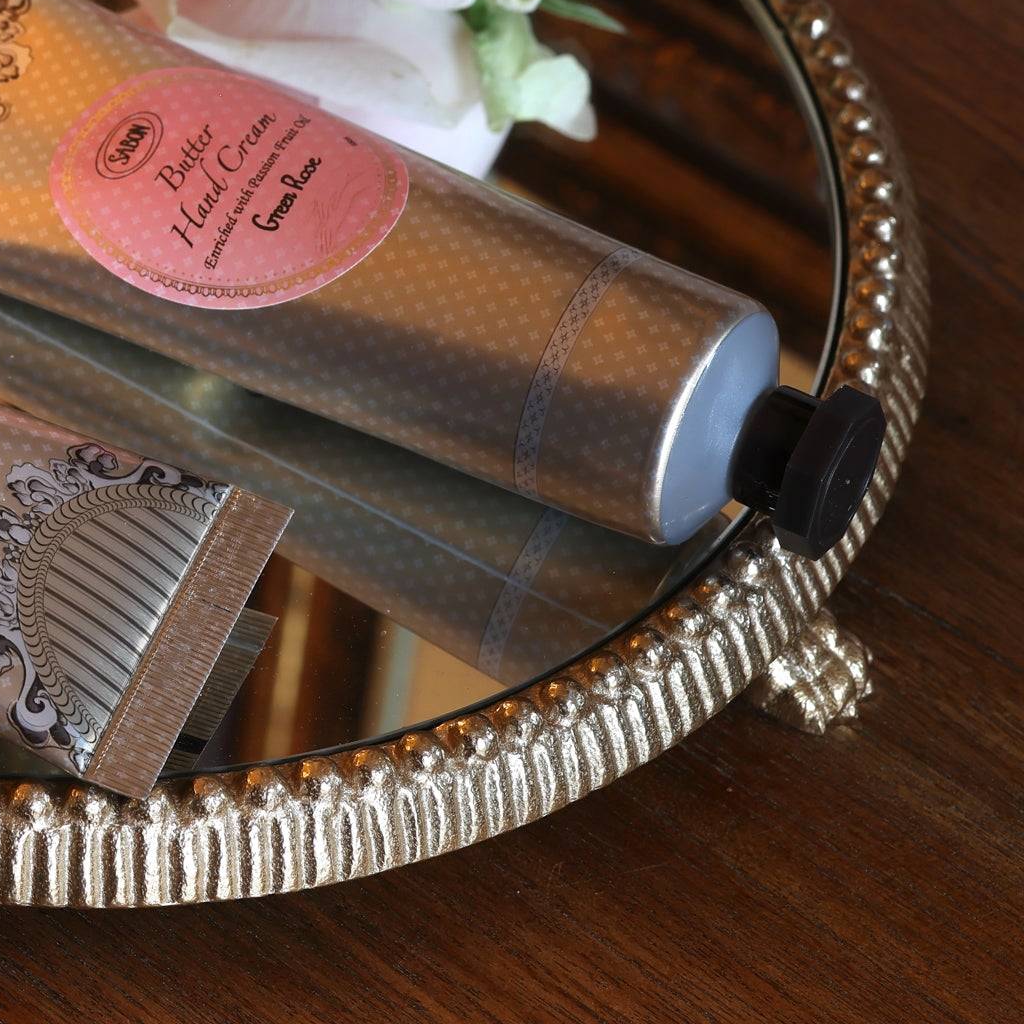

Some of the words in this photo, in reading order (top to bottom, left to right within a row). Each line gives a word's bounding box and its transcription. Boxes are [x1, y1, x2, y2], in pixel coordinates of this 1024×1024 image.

[107, 123, 151, 166] SABON
[154, 124, 214, 193] Butter
[170, 157, 229, 249] Hand
[217, 112, 277, 173] Cream
[204, 212, 238, 270] Enriched
[233, 187, 255, 217] with
[247, 151, 280, 189] Passion
[274, 128, 299, 152] Fruit
[251, 190, 298, 232] Green
[280, 156, 322, 191] Rose
